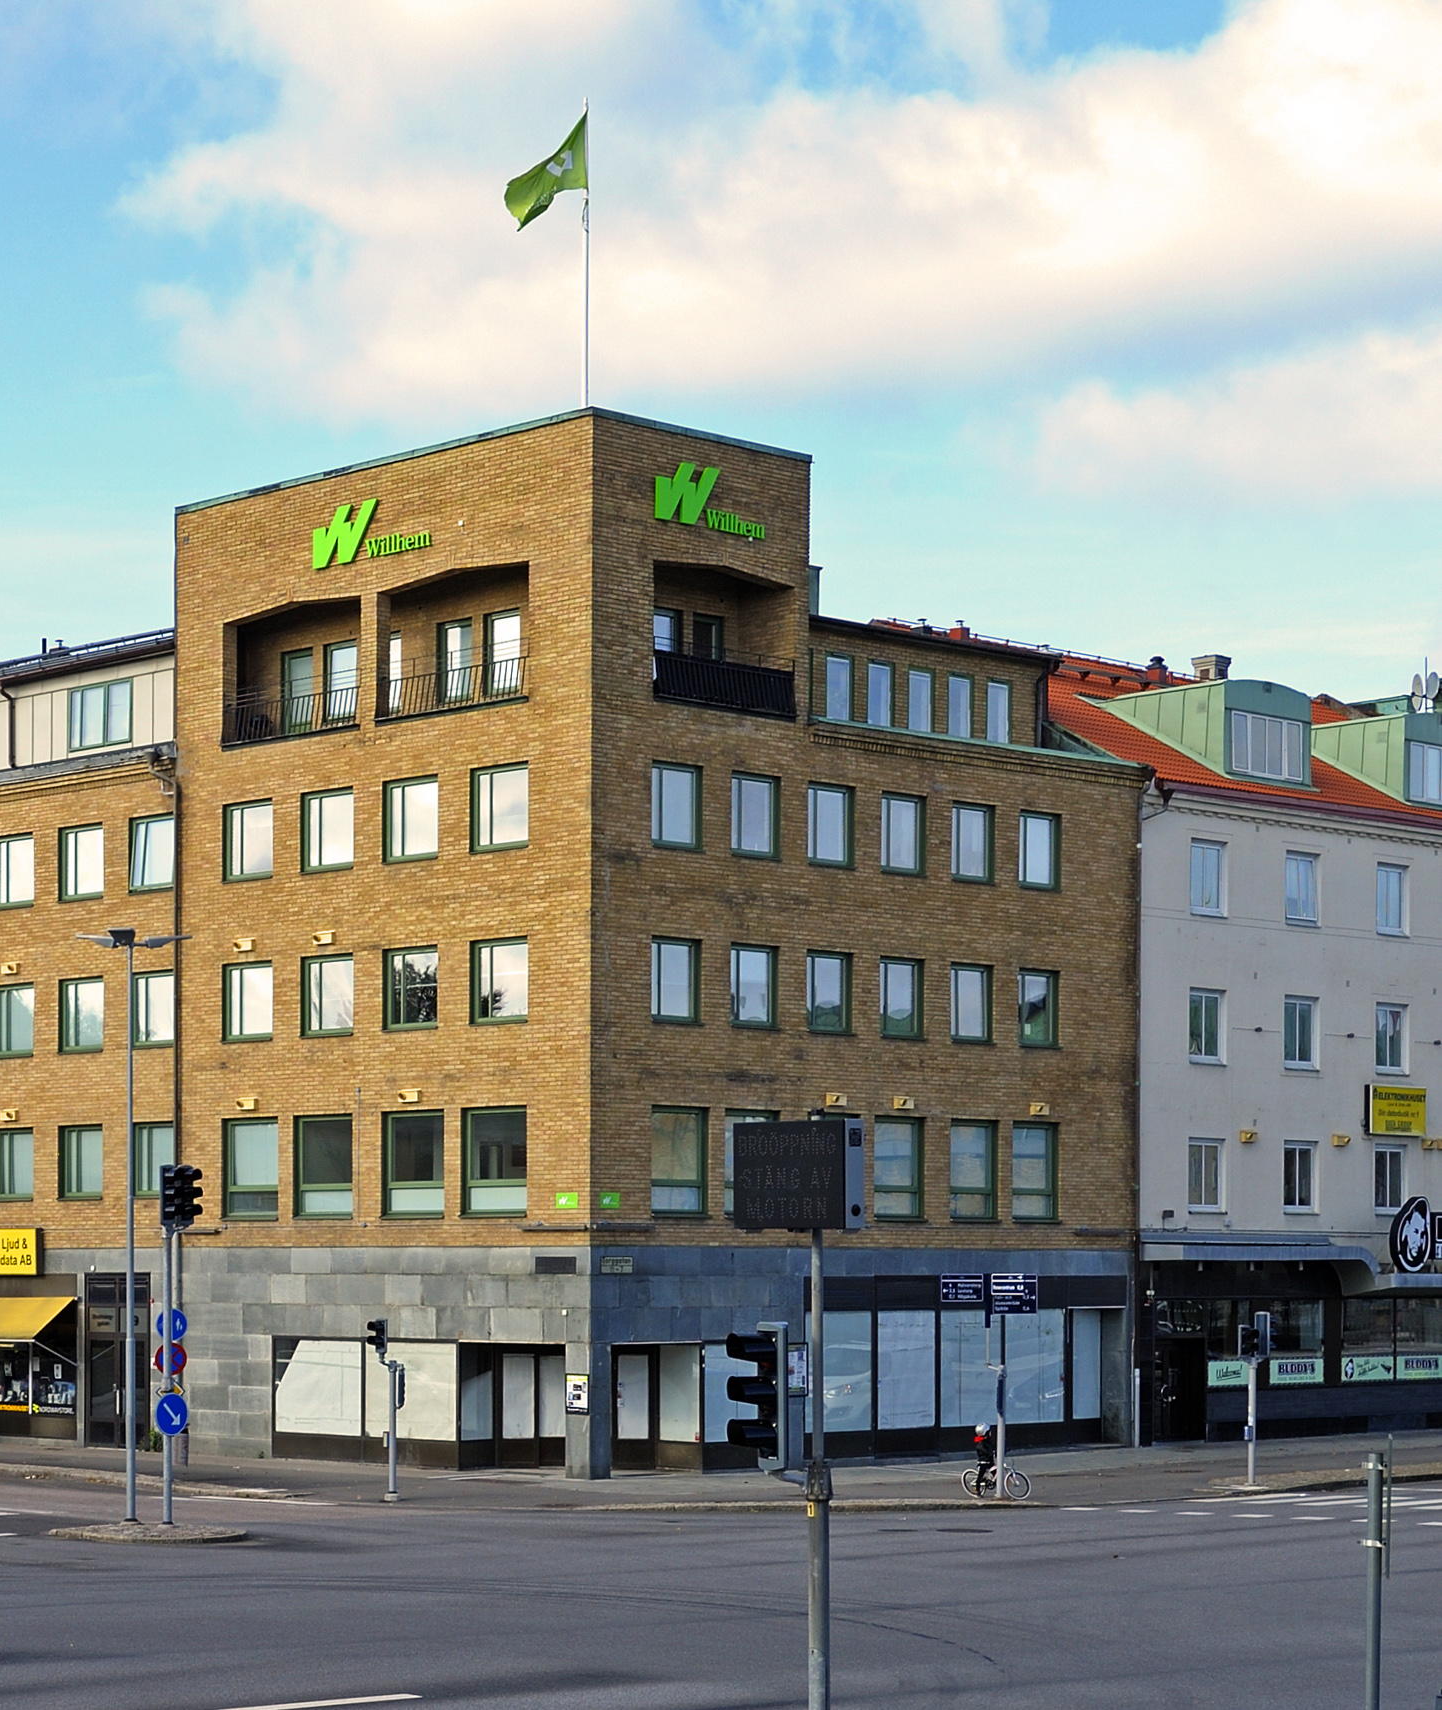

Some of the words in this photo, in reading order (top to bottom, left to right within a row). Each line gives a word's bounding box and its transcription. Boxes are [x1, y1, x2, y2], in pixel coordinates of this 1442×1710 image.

[706, 508, 765, 539] Willhem
[365, 532, 431, 558] Willhem
[1378, 1092, 1426, 1103] ELEKTRONIKHUSET
[740, 1165, 800, 1189] STÄNG
[810, 1167, 833, 1189] AV
[747, 1197, 827, 1219] MOTORN
[1, 1237, 20, 1252] Ljud
[21, 1237, 28, 1250] &
[0, 1254, 18, 1266] data
[19, 1254, 33, 1266] AB
[1278, 1361, 1316, 1375] BUDDY'S
[1404, 1358, 1439, 1371] BUDDY'S
